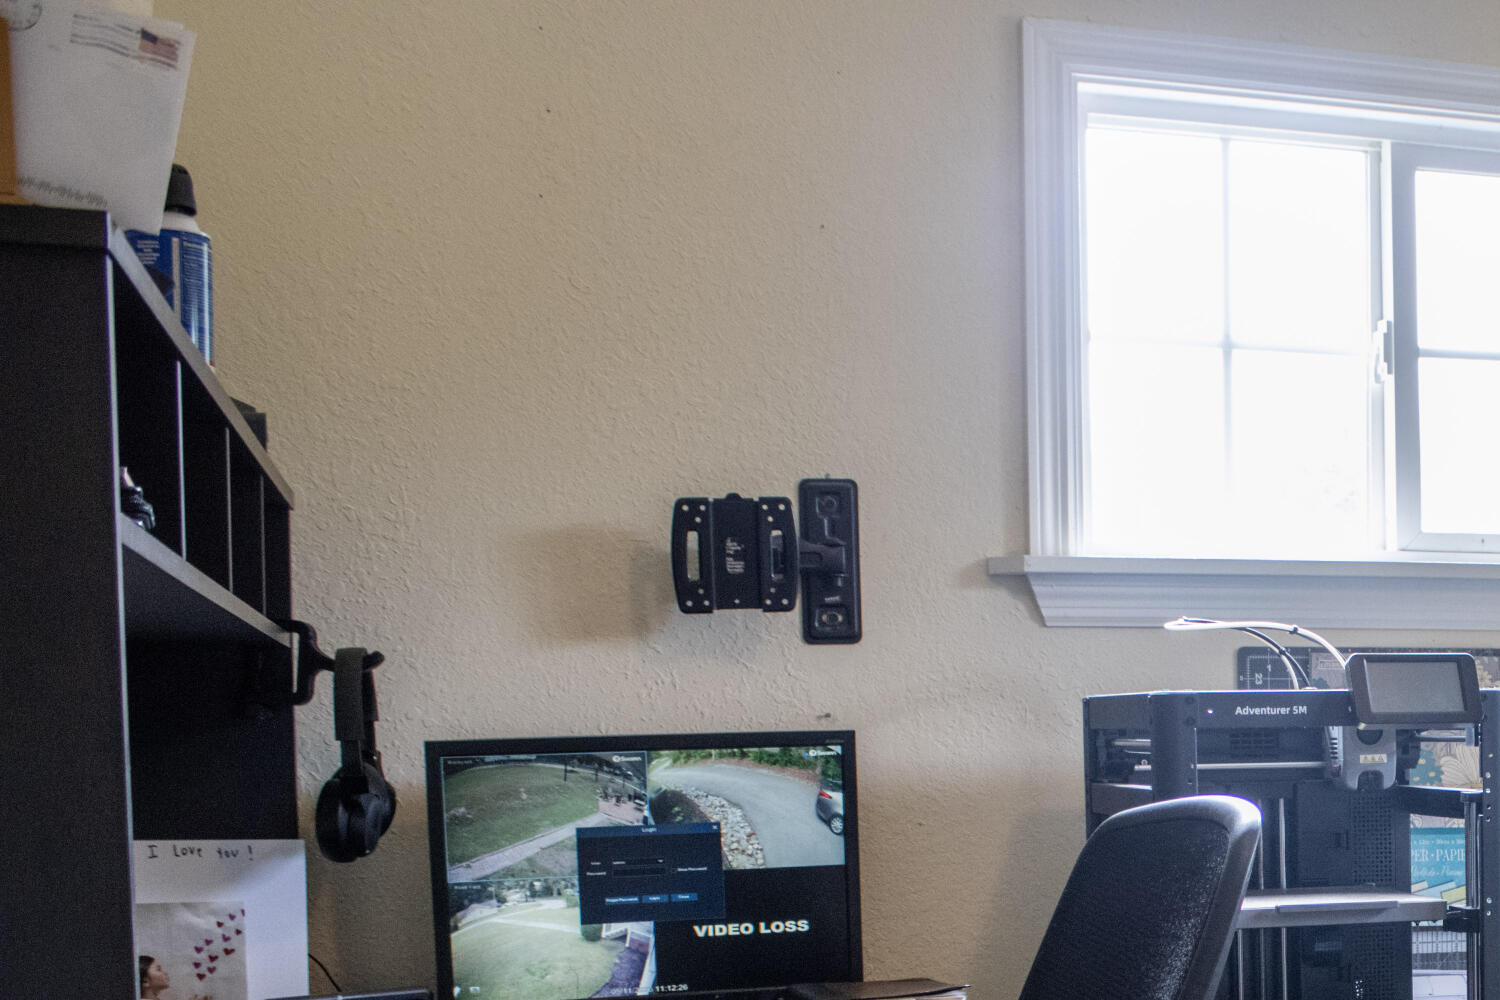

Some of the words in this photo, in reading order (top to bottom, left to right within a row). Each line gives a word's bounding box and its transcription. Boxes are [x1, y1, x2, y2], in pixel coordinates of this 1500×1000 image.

[1234, 706, 1291, 716] Adventurer
[1292, 705, 1308, 715] 5M
[147, 844, 159, 859] I
[693, 922, 754, 938] VIDEO
[758, 919, 810, 935] LOSS
[655, 983, 689, 993] 11:12:26
